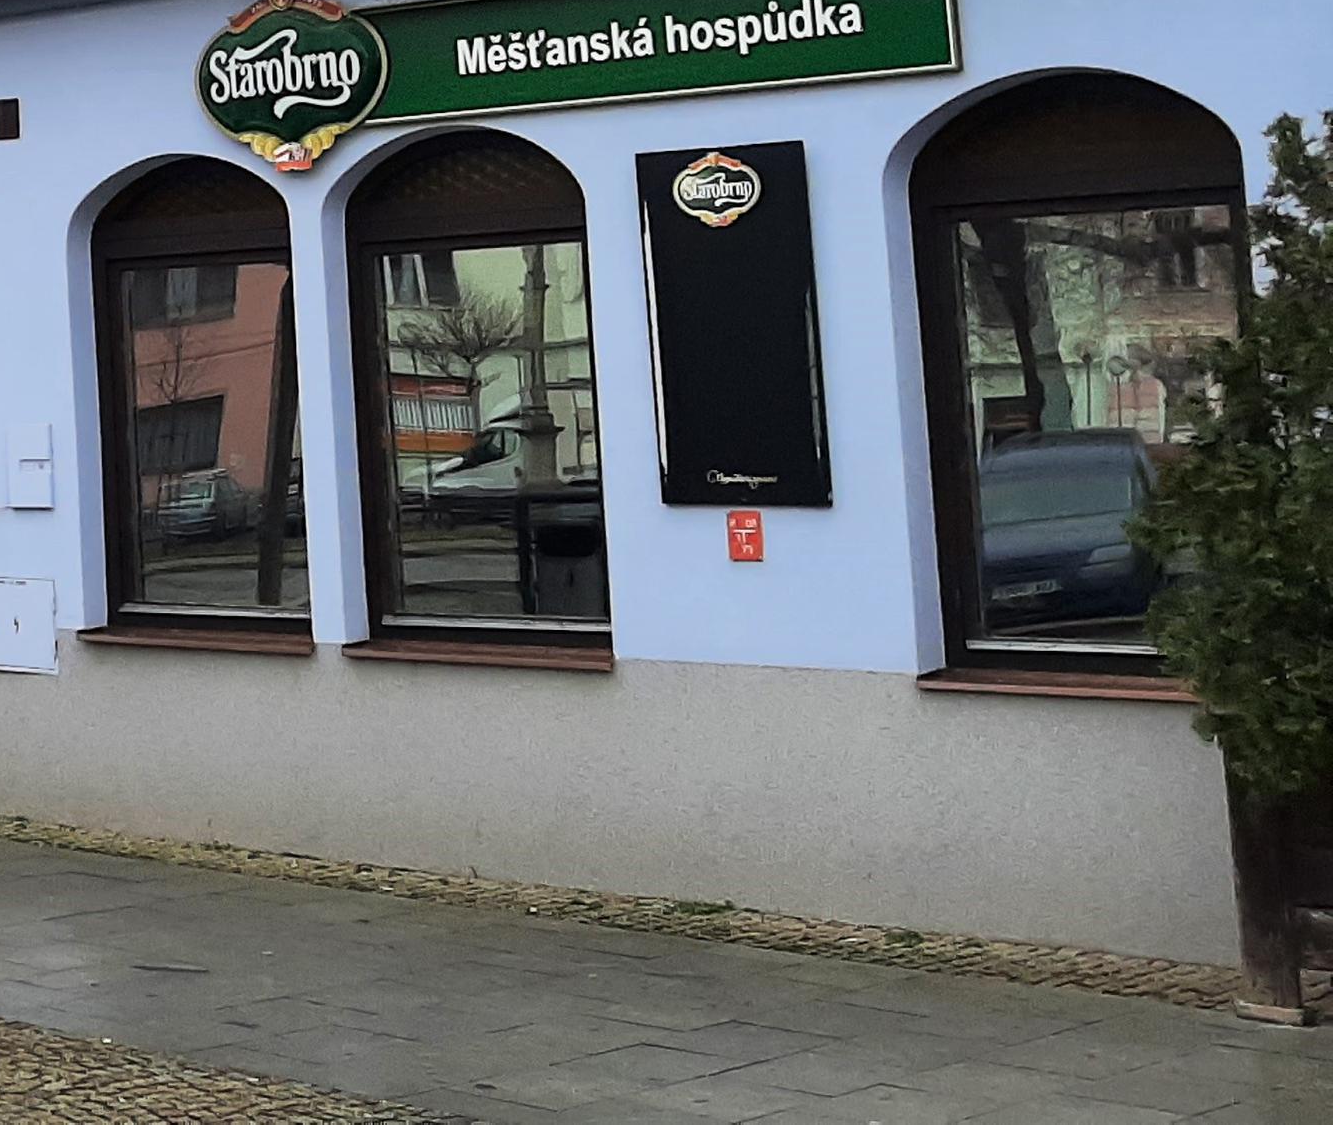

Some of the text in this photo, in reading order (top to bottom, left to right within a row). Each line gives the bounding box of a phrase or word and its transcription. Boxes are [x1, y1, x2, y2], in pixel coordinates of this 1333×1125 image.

[209, 29, 361, 120] Starobrno
[456, 17, 655, 76] Měšťanská
[679, 172, 753, 207] Starobrno
